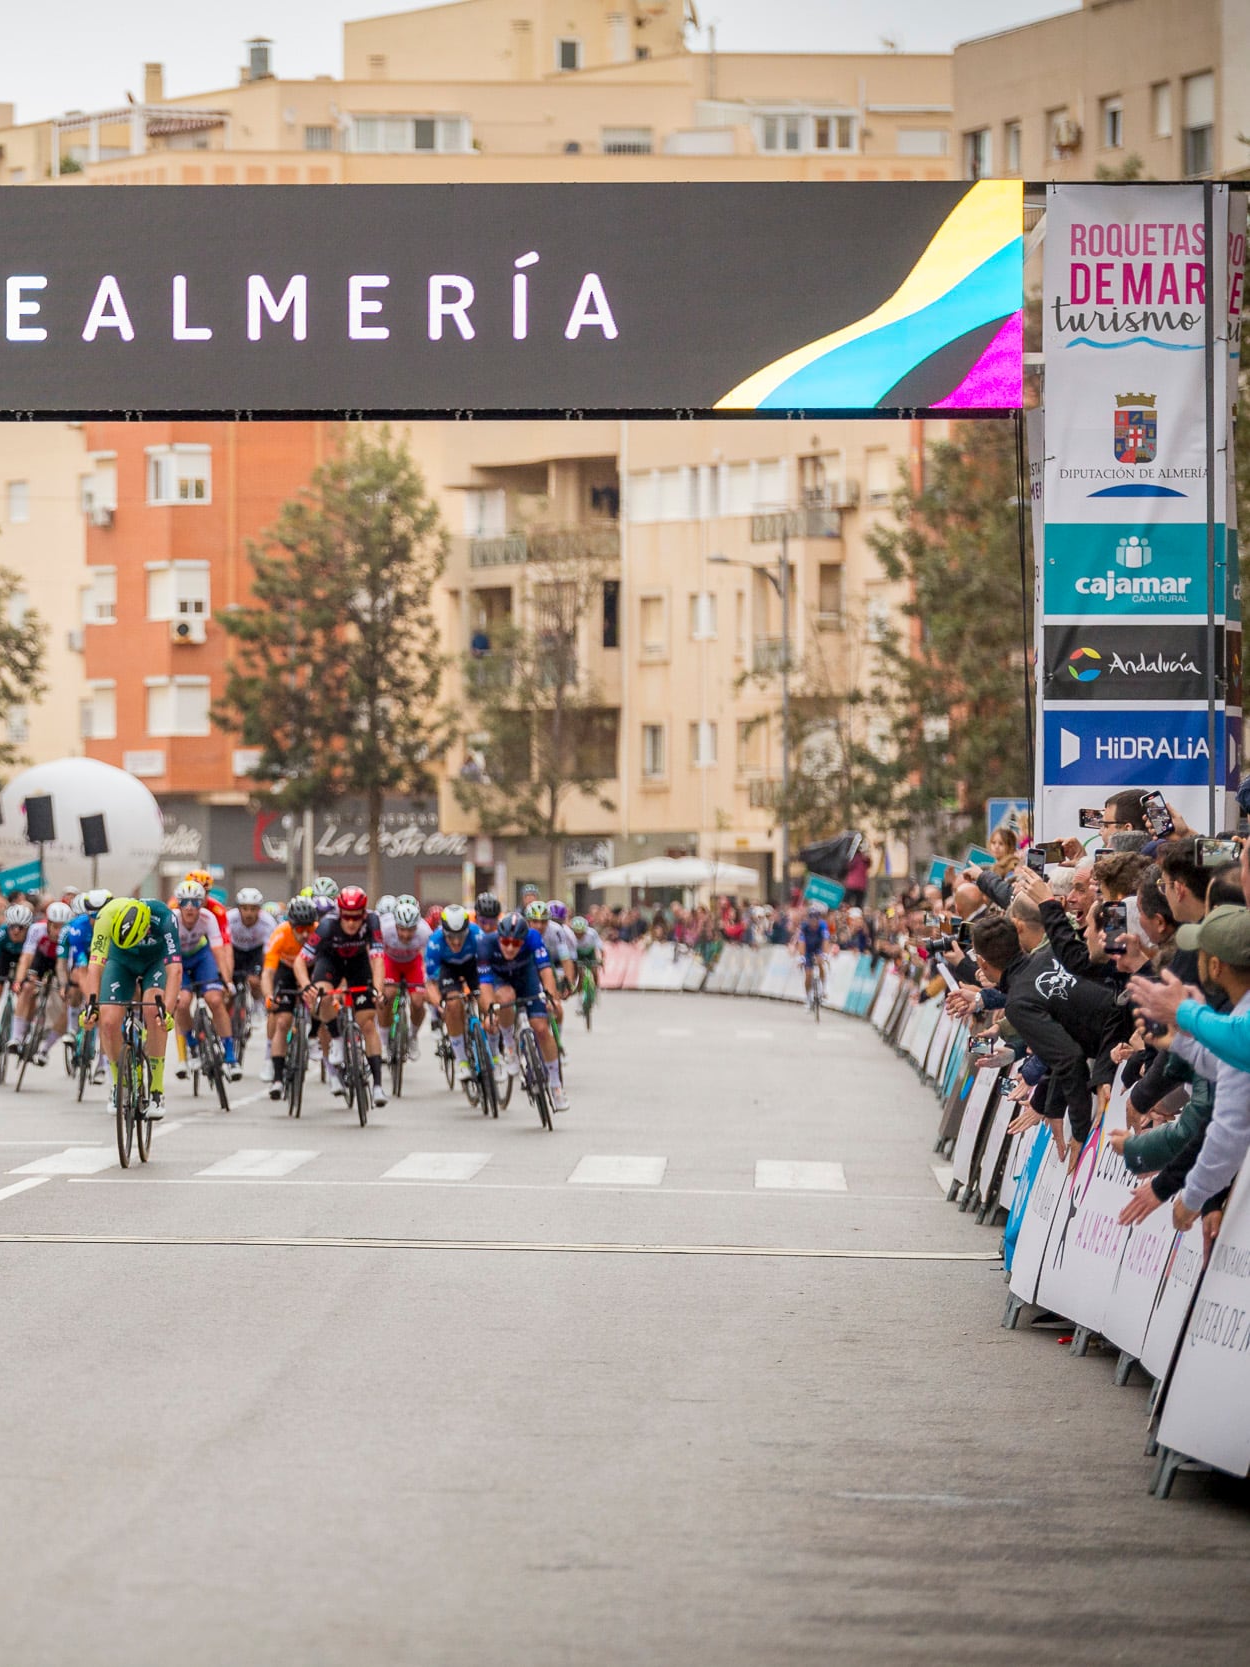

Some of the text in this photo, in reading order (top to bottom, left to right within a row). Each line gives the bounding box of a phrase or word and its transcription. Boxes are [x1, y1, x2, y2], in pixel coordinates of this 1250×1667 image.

[1070, 223, 1206, 257] ROQUETAS
[1051, 296, 1201, 332] turismo
[1060, 467, 1135, 480] DIPUTACIÓN
[1139, 468, 1155, 479] DE
[1075, 571, 1192, 601] cajamar
[1132, 594, 1189, 603] CAJA RURAL
[1108, 652, 1202, 674] Andalucía
[164, 933, 177, 955] BORA
